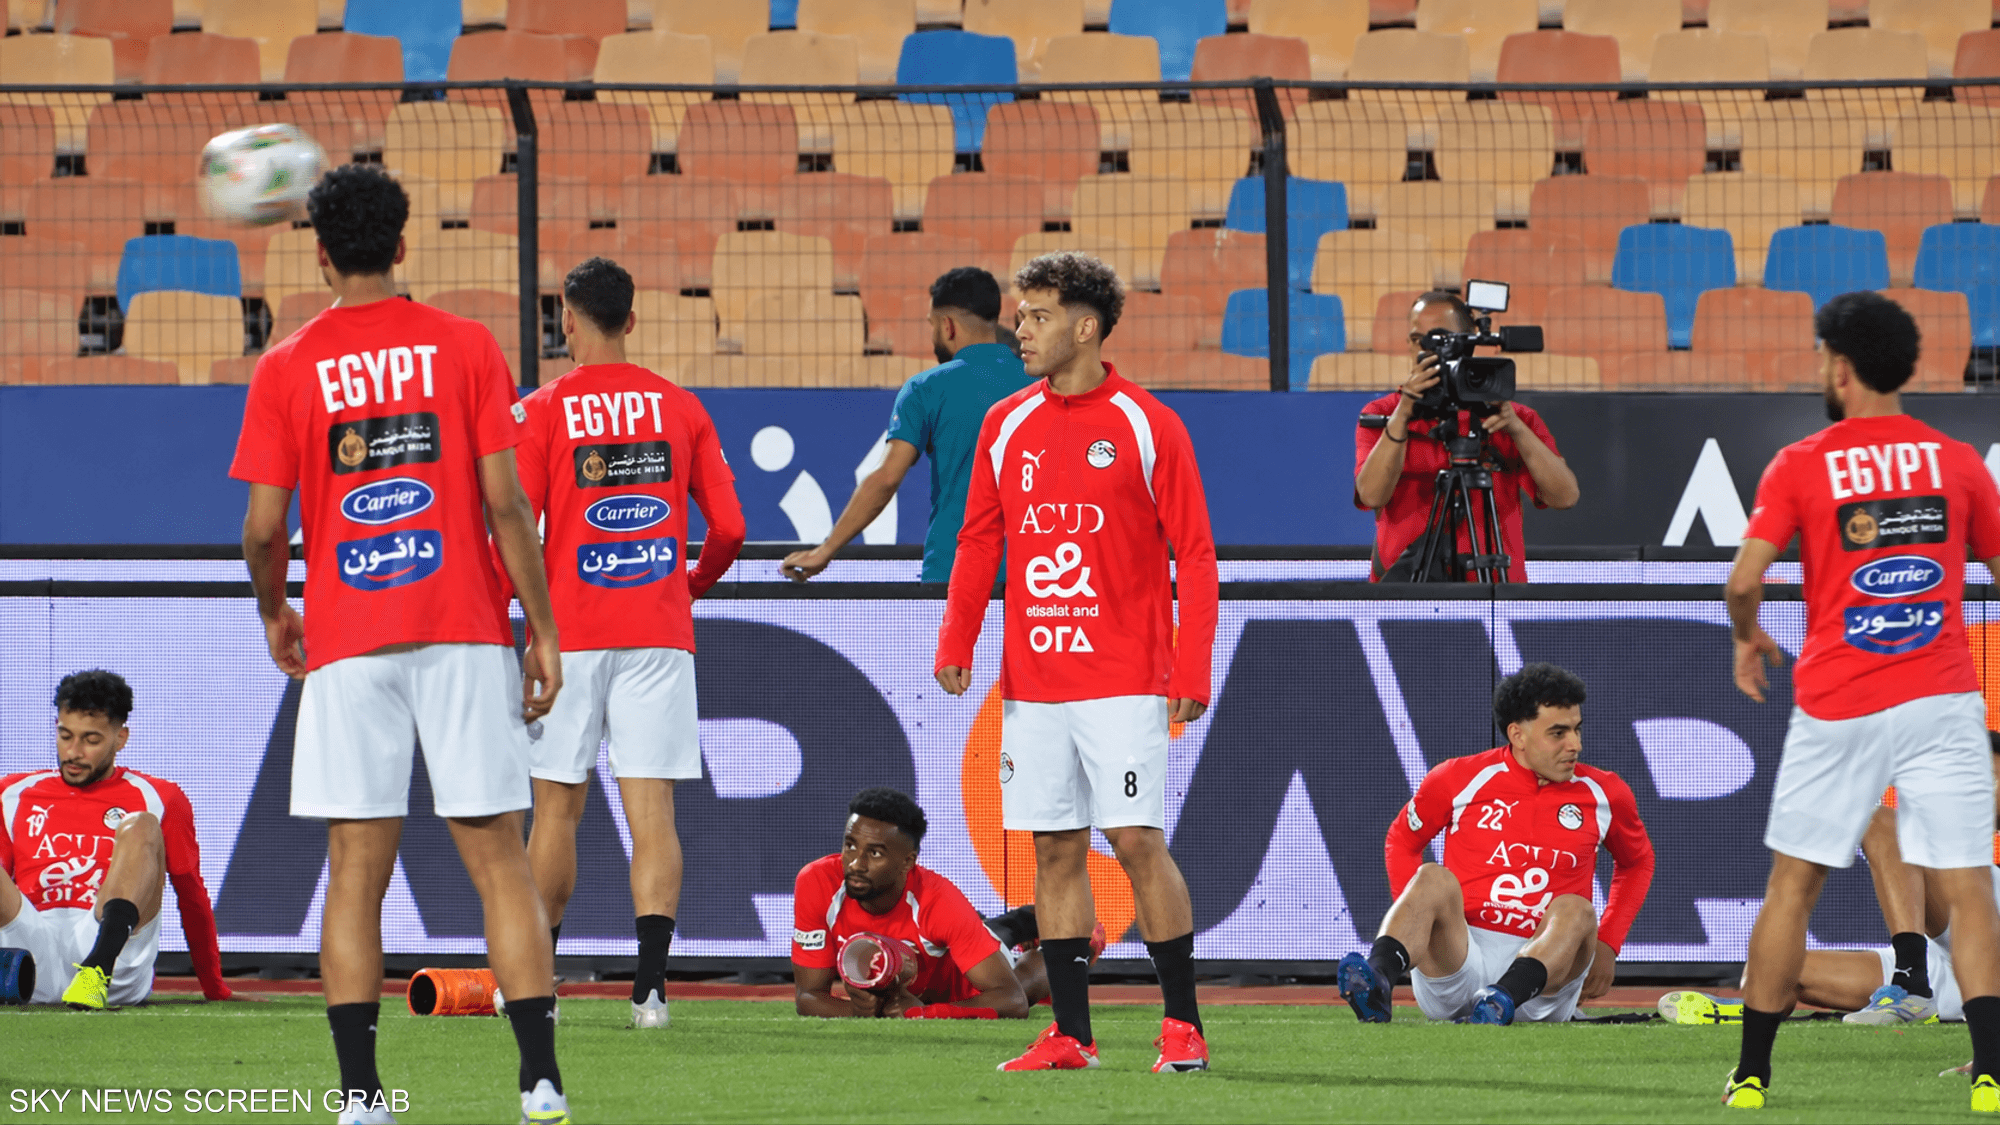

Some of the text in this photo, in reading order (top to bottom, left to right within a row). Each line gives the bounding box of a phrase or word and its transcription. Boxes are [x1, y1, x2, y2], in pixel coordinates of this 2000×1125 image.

[316, 345, 437, 413] EGYPT
[562, 391, 663, 439] EGYPT
[1022, 464, 1034, 492] 8
[1824, 441, 1943, 500] EGYPT
[353, 488, 420, 513] Carrier
[597, 503, 658, 521] Carrier
[1019, 503, 1105, 534] ACUD
[344, 537, 435, 575] دانون
[583, 545, 672, 573] دانون
[1025, 541, 1098, 599] e&
[1863, 565, 1934, 587] Carrier
[1026, 604, 1099, 617] etisalat and
[1848, 608, 1942, 635] دانون
[1124, 770, 1138, 798] 8
[26, 814, 45, 838] 19
[1477, 805, 1505, 831] 22
